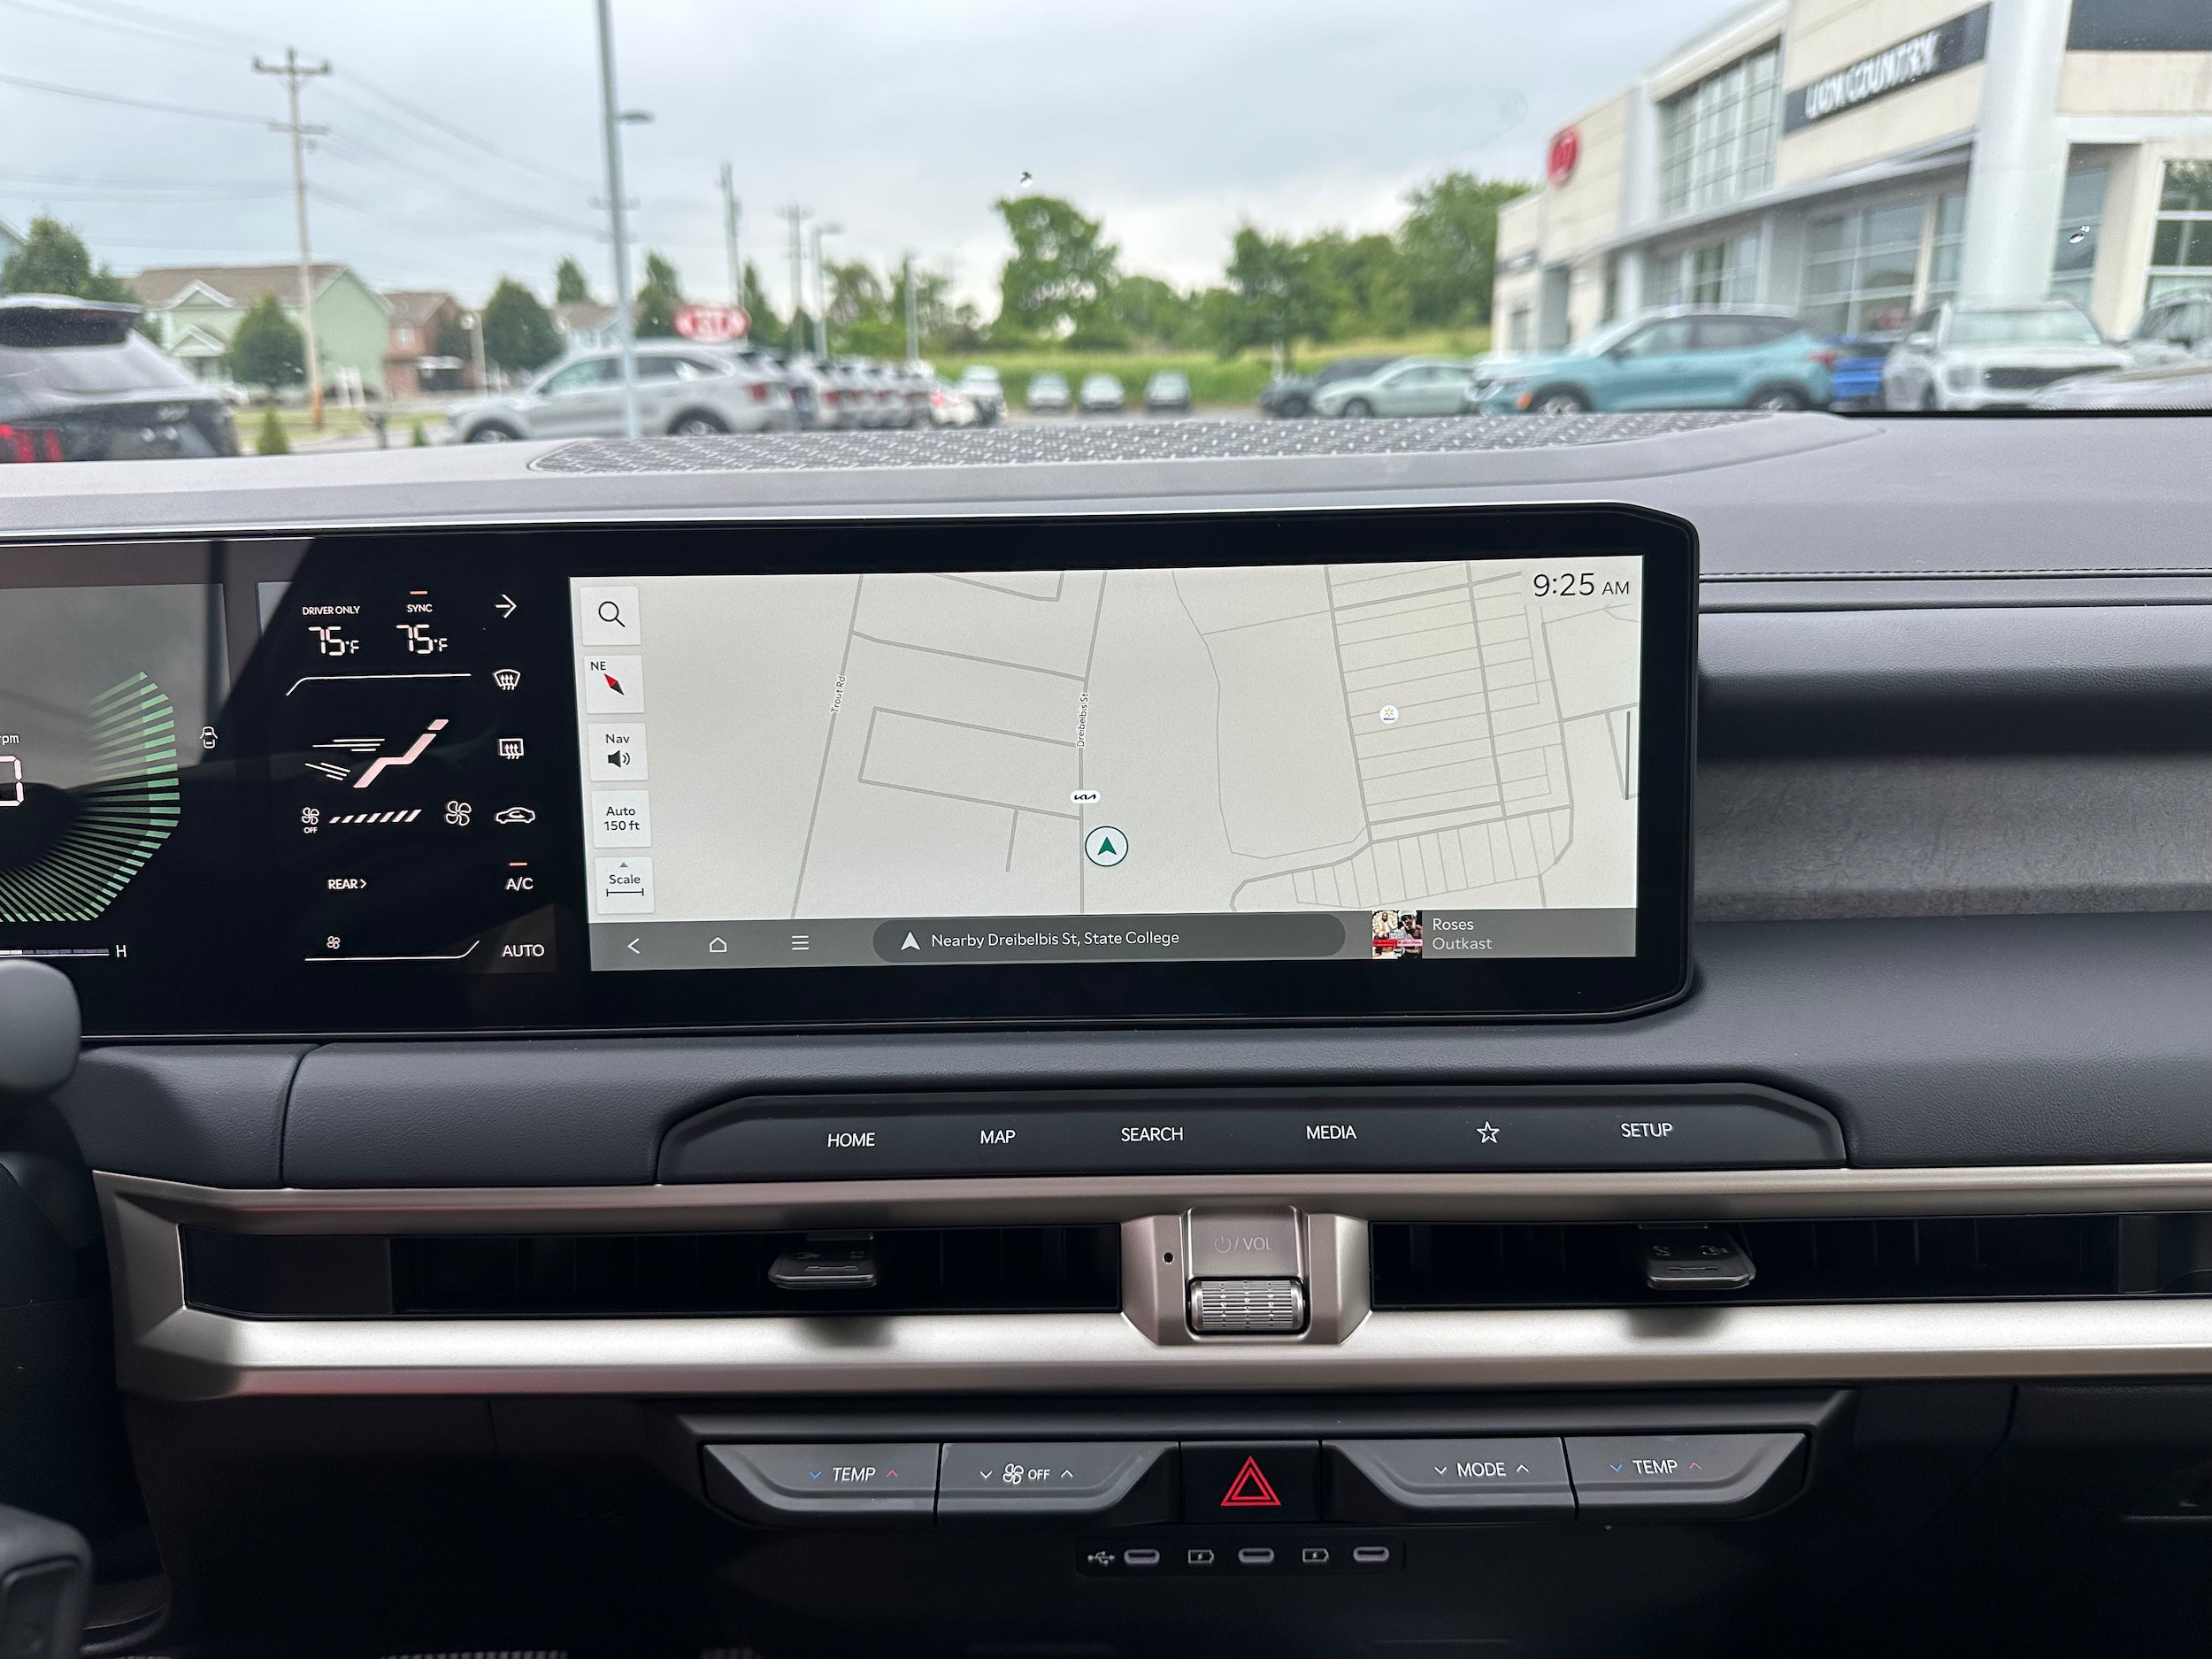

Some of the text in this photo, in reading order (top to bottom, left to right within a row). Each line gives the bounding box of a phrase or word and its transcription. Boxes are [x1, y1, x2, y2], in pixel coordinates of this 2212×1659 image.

[1533, 572, 1629, 597] 9:25 AM
[302, 605, 361, 616] DRIVER ONLY
[406, 603, 434, 613] SYNC
[590, 661, 607, 671] NE
[830, 675, 846, 713] Trout Rd
[1076, 692, 1089, 747] Dreibelbis St
[0, 734, 19, 746] pm
[605, 733, 630, 744] Nav
[606, 806, 636, 817] Auto
[603, 820, 641, 831] 150 ft
[327, 879, 358, 890] REAR
[505, 876, 534, 892] A/C
[609, 874, 641, 885] Scale
[1432, 918, 1474, 931] Roses
[932, 931, 1179, 949] Nearby Dreibelbis St, State College
[1432, 937, 1493, 950] Outkast
[115, 944, 127, 958] H
[502, 943, 545, 957] AUTO
[980, 1129, 1016, 1144] MAP
[1121, 1126, 1184, 1142] SEARCH
[1306, 1125, 1357, 1140] MEDIA
[1620, 1122, 1673, 1138] SETUP
[827, 1132, 876, 1148] HOME
[1456, 1462, 1507, 1478] MODE
[1632, 1459, 1678, 1474] TEMP
[833, 1467, 876, 1482] TEMP
[1027, 1469, 1050, 1480] OFF
